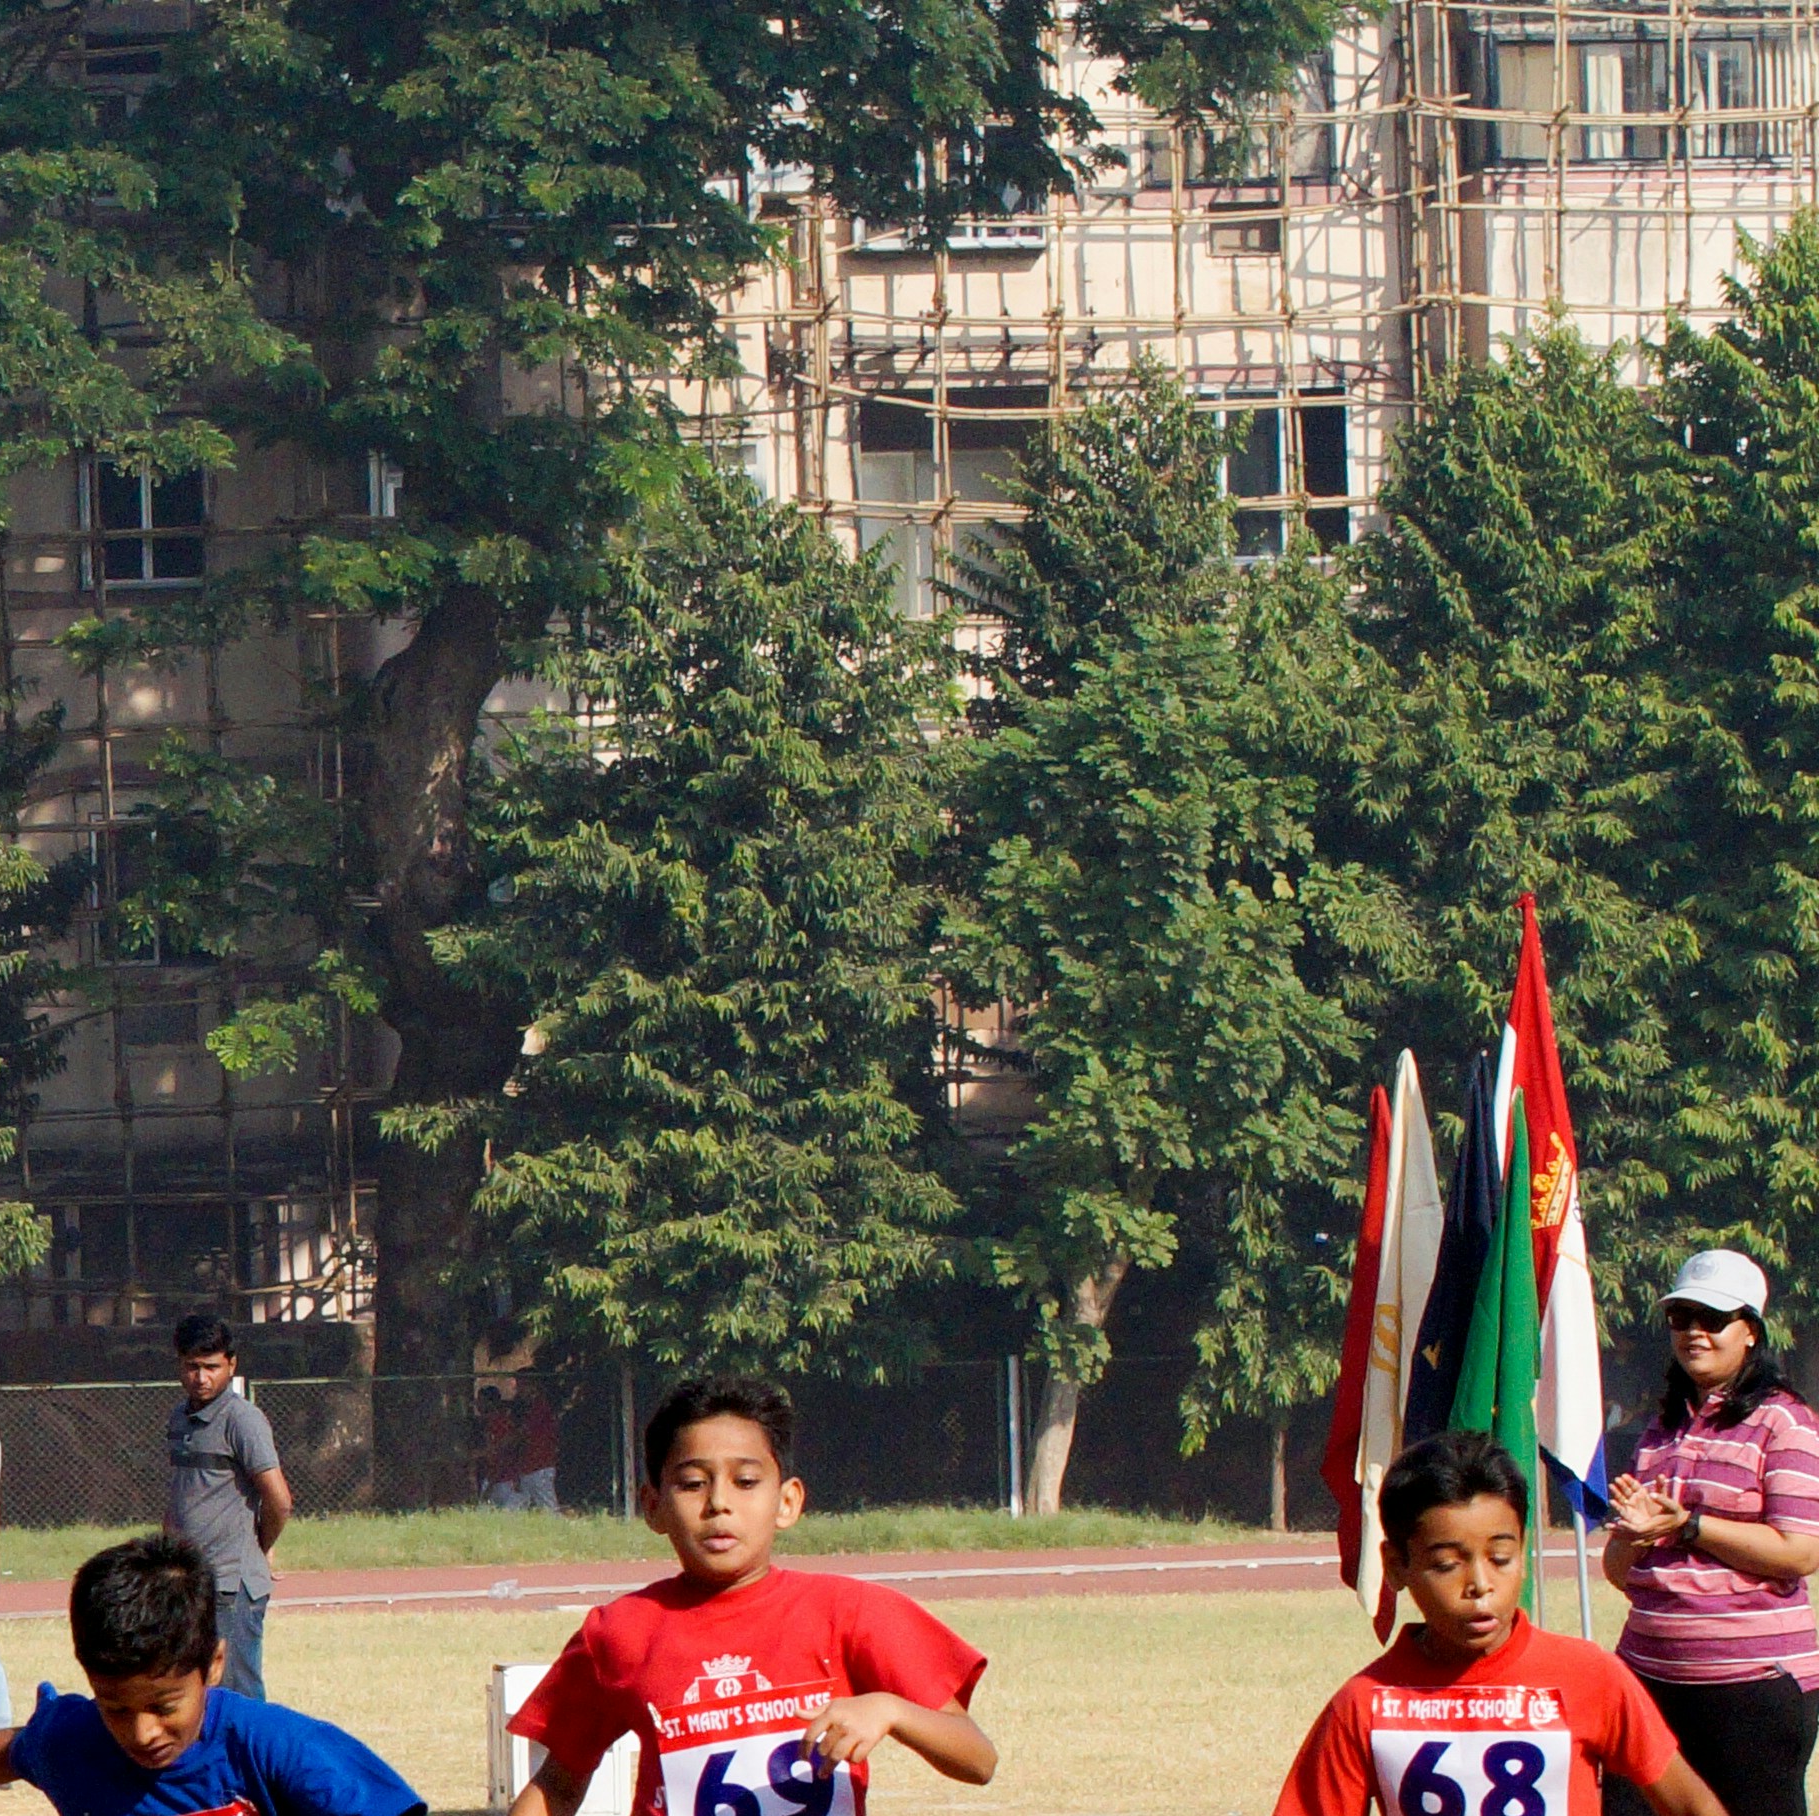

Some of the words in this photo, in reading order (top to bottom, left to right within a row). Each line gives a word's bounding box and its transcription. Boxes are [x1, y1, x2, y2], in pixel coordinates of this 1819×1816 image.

[1382, 1699, 1403, 1717] ST.
[1408, 1699, 1463, 1719] MARY'S
[1468, 1699, 1524, 1719] SCHOOL
[664, 1719, 686, 1739] ST.
[688, 1706, 742, 1734] MARY'S
